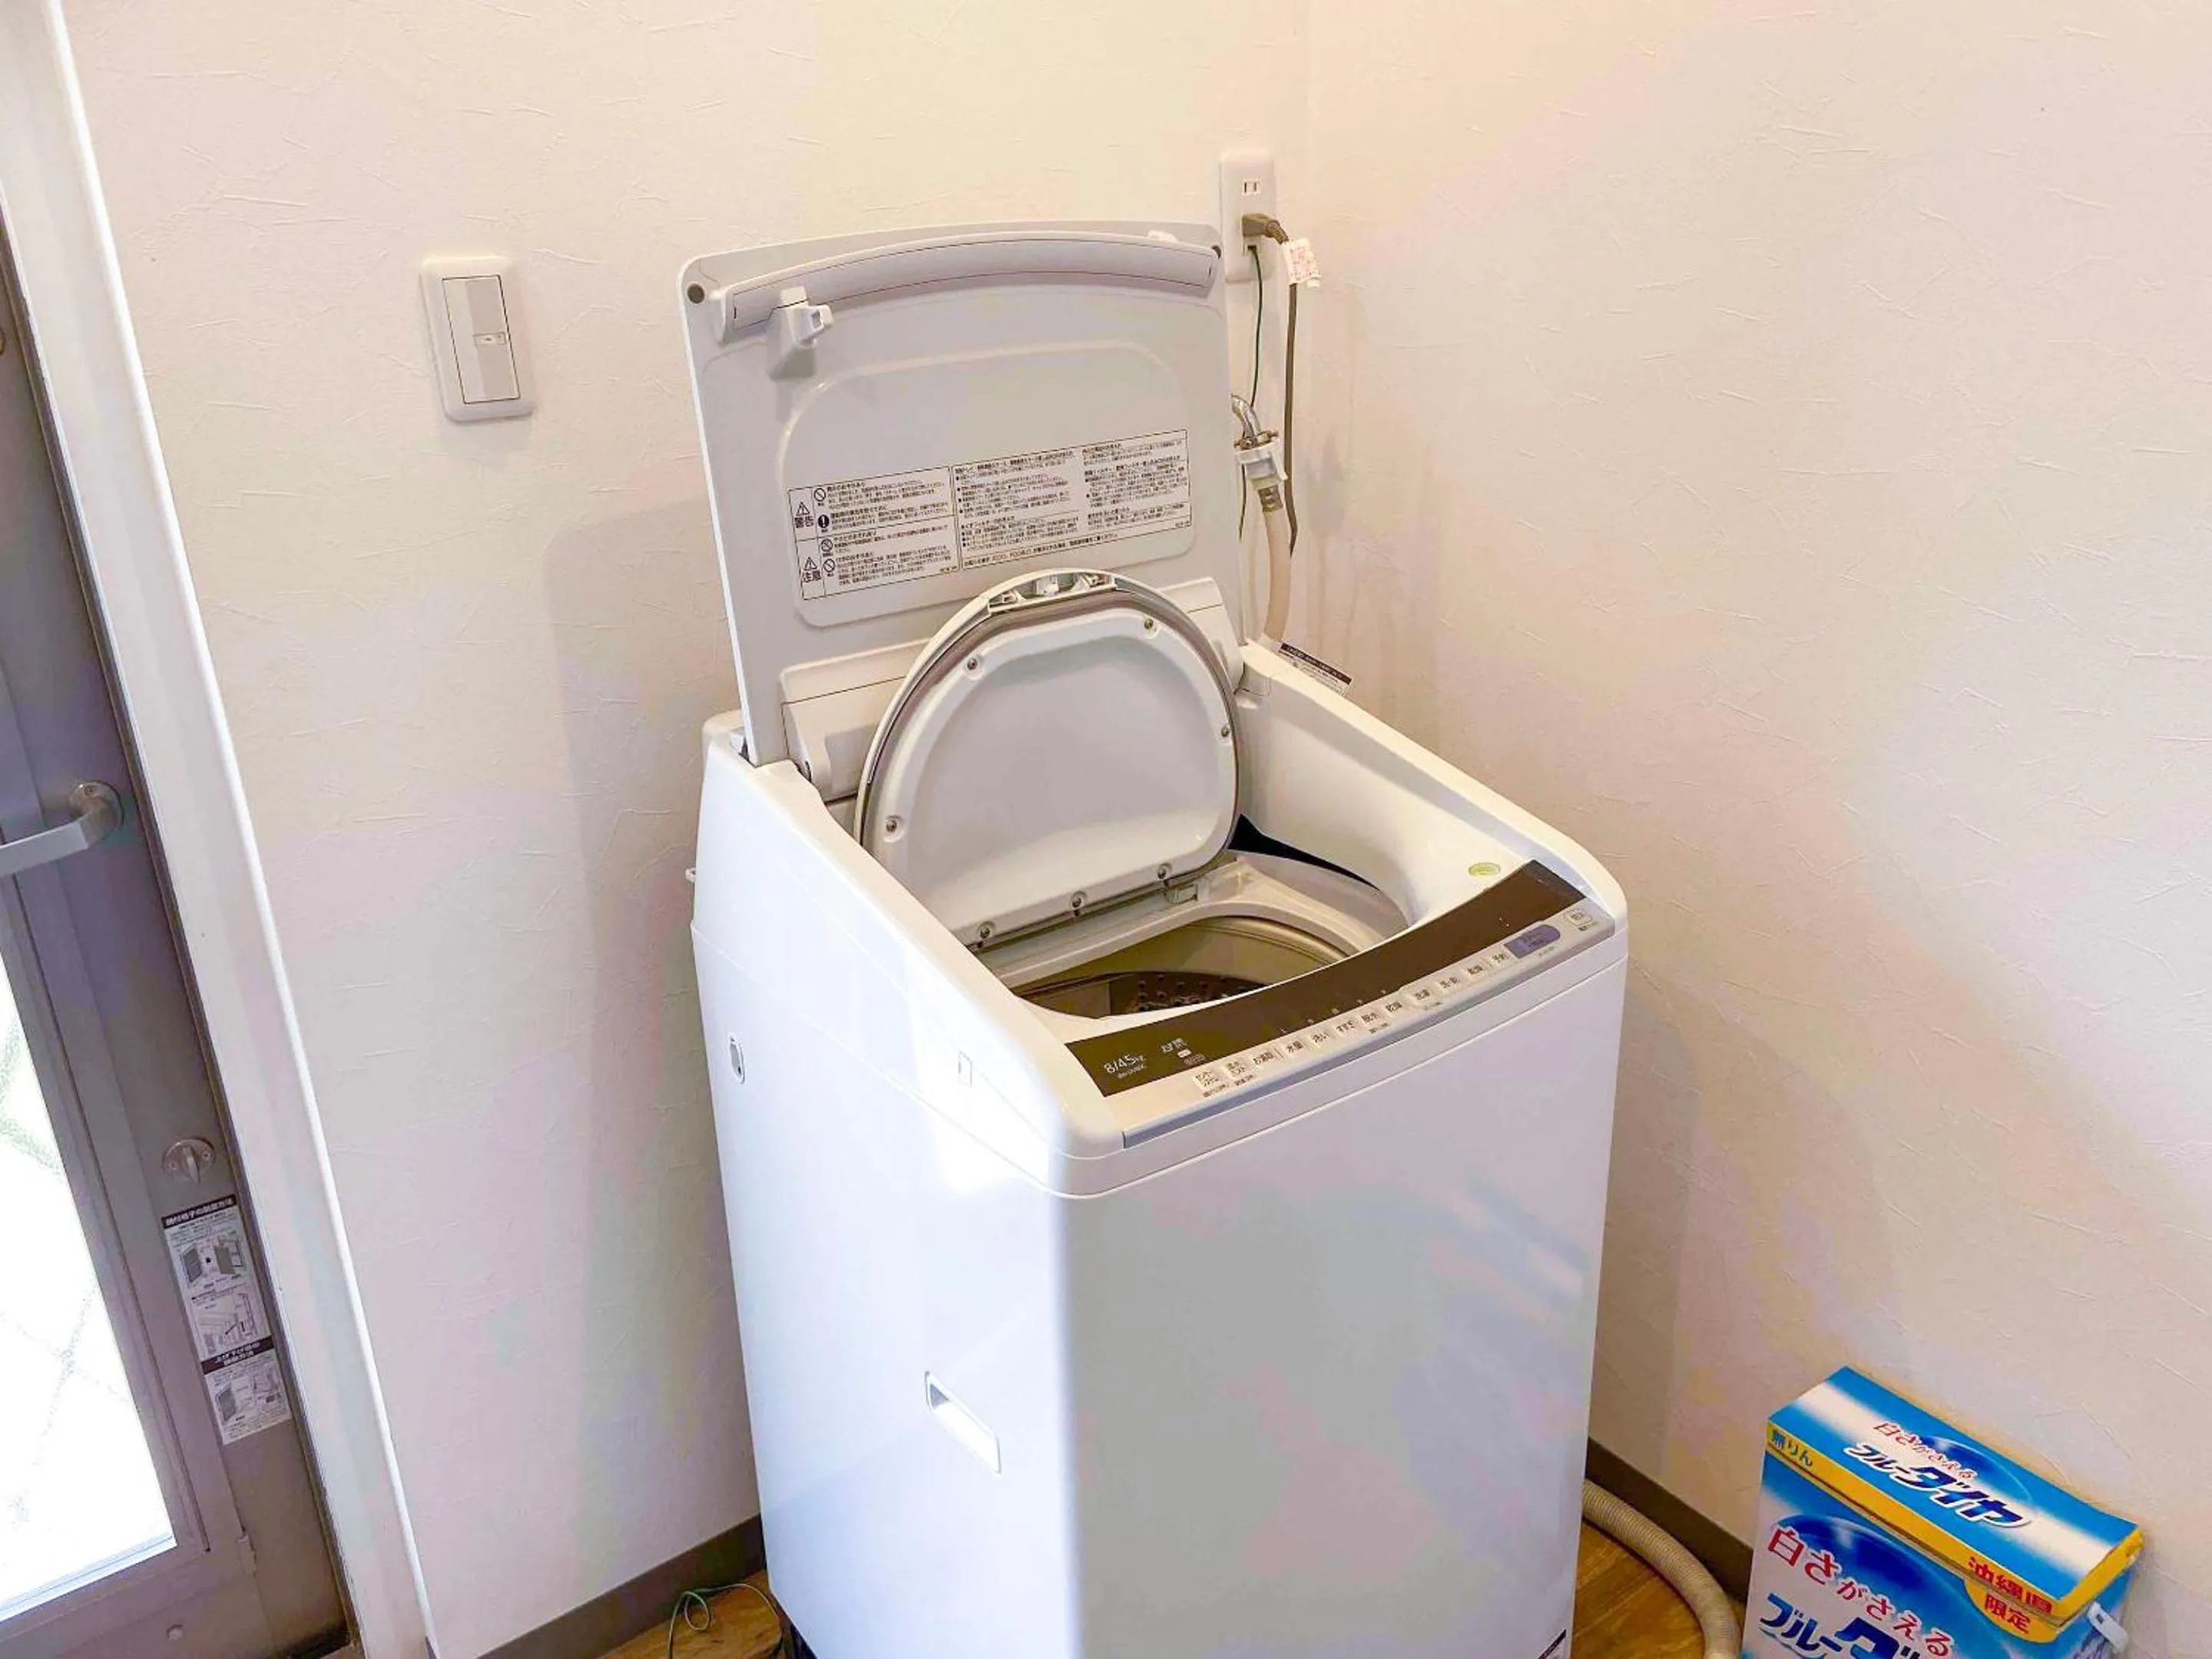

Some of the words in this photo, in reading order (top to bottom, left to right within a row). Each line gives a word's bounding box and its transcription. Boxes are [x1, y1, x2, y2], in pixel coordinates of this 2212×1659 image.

[794, 516, 814, 528] 警告
[803, 571, 821, 583] 注意
[1772, 1430, 1813, 1467] 無りん
[1873, 1422, 1975, 1479] 白さがさえる
[1845, 1443, 2030, 1526] ブルーダイヤ
[1768, 1528, 1952, 1657] 白さがさえる
[1969, 1557, 2052, 1614] 沖縄県
[1985, 1593, 2031, 1634] 限定
